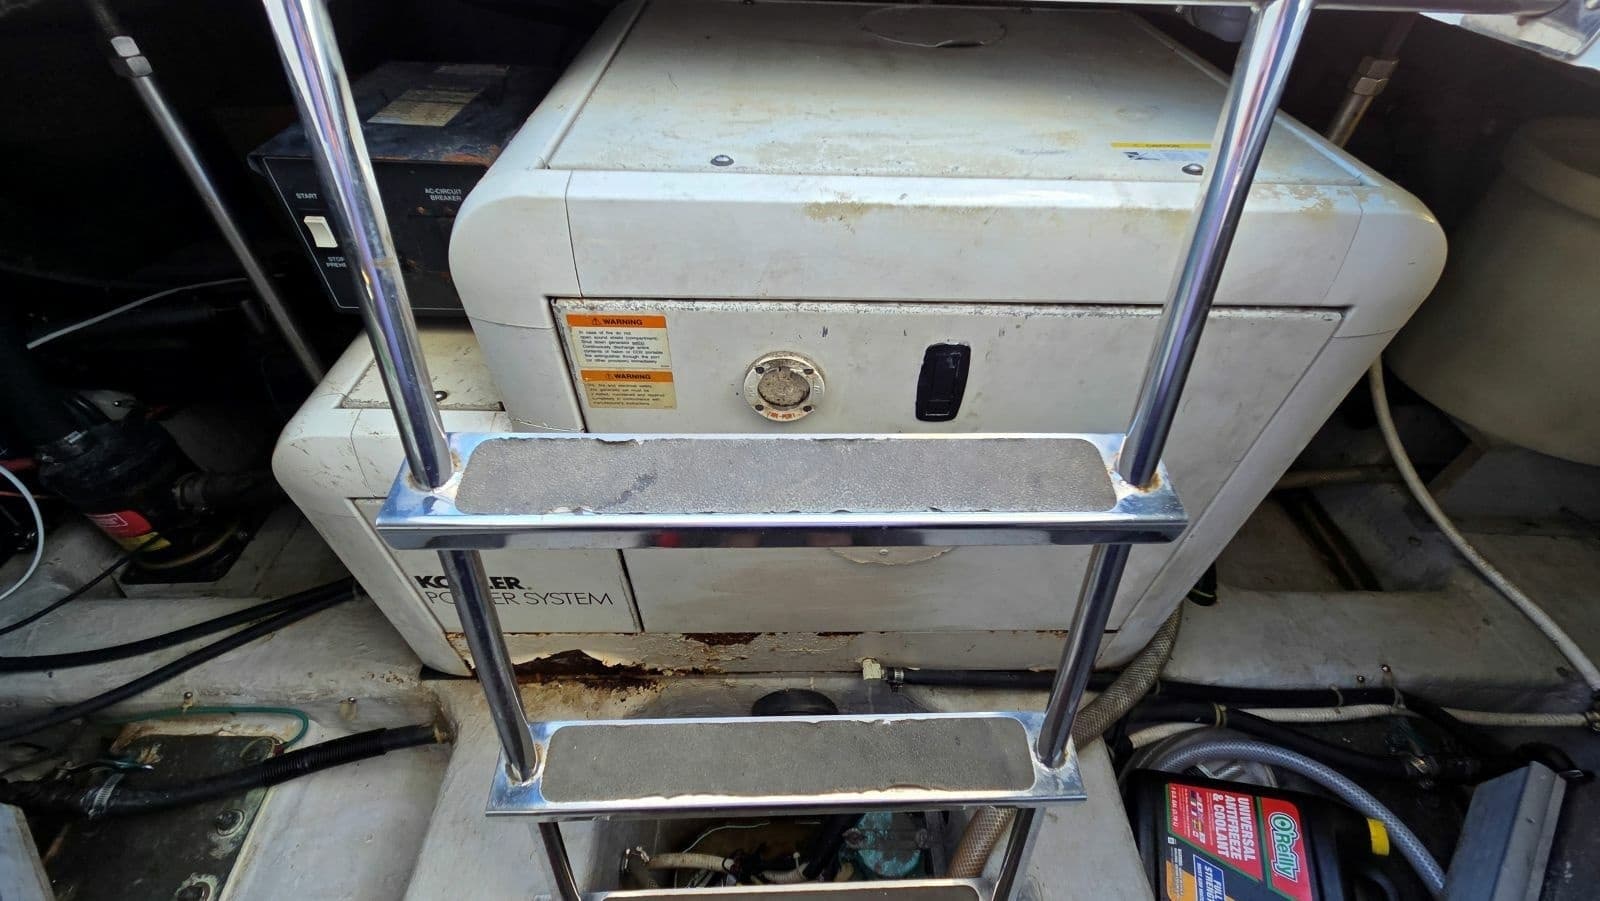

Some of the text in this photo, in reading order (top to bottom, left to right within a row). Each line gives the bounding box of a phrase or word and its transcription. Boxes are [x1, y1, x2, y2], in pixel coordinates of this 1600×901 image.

[425, 592, 614, 605] POER SYSTEM
[1213, 793, 1229, 858] & COOLANT
[1225, 795, 1242, 860] ANTIFREEZE
[1238, 797, 1256, 861] UNIVERSAL
[1270, 814, 1298, 881] O'Reilly
[1214, 880, 1223, 900] FULL
